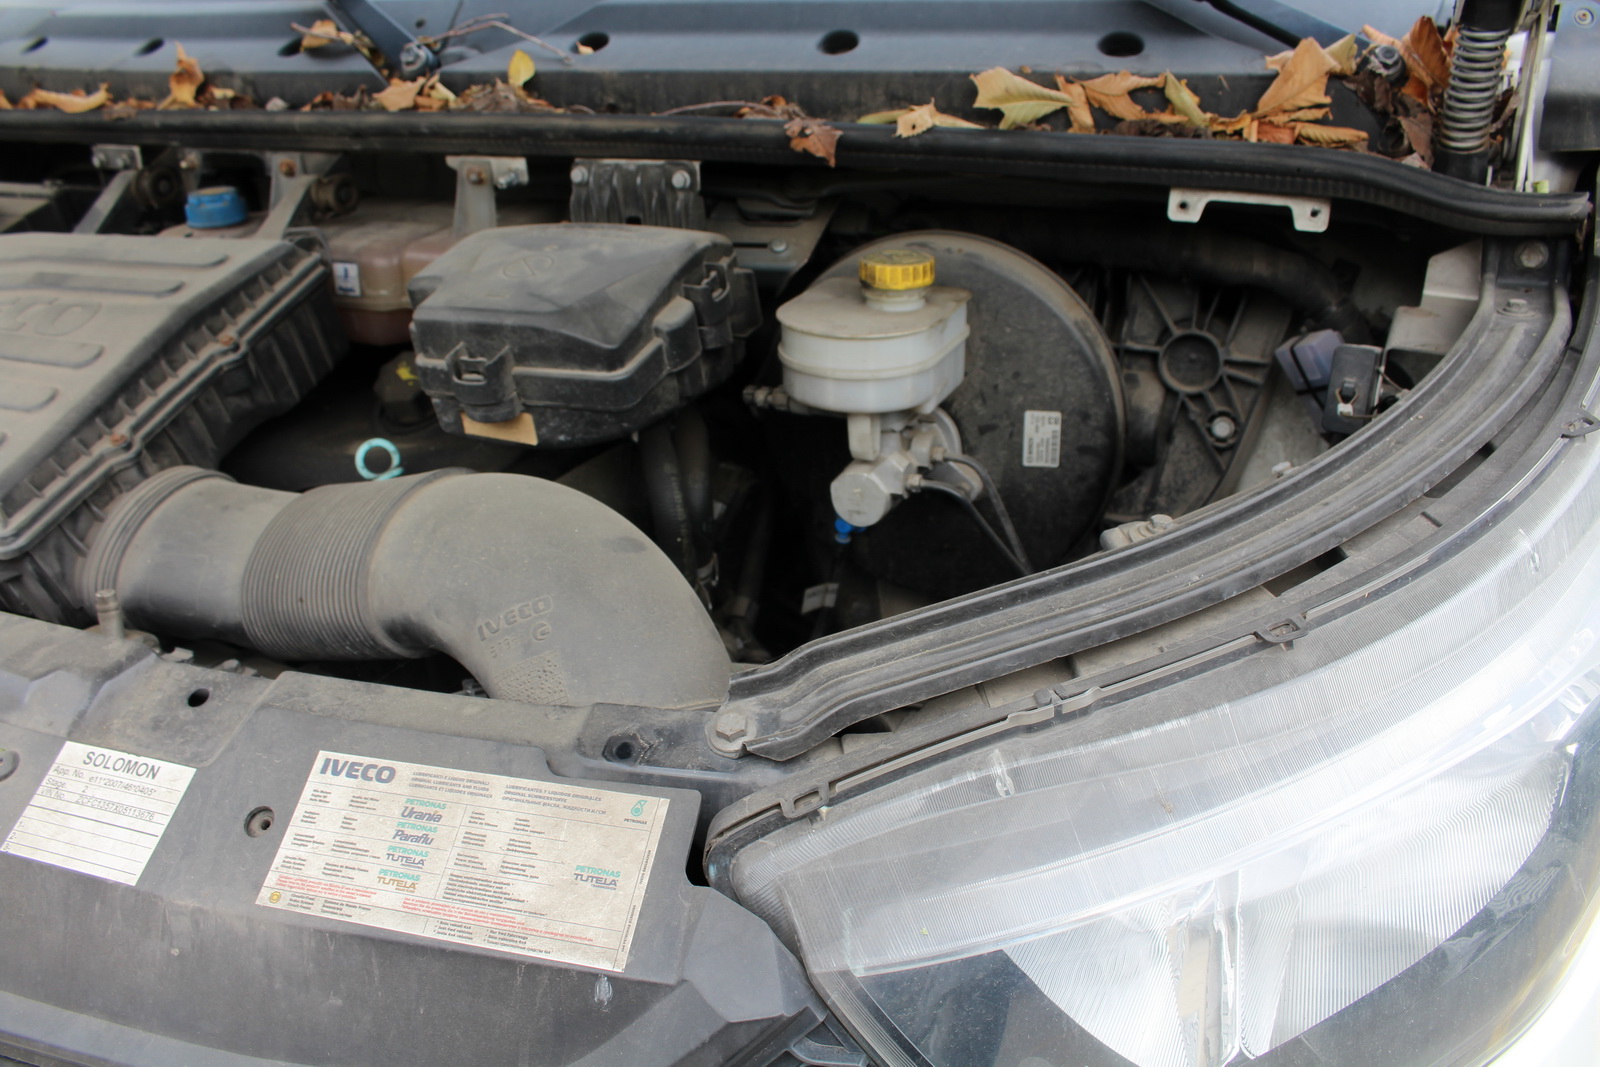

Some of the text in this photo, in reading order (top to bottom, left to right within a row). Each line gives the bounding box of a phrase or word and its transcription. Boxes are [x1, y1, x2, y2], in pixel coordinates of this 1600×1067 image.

[477, 595, 553, 642] IVECO
[83, 750, 161, 780] SOLOMON
[320, 758, 396, 783] IVECO
[81, 785, 89, 793] 2
[405, 798, 447, 810] PETRONAS
[401, 806, 443, 823] Urania
[397, 821, 438, 833] PETRONAS
[392, 829, 434, 845] Paraflu
[387, 845, 429, 858] PETRONAS
[386, 852, 426, 866] TUTELA
[379, 868, 420, 882] PETRONAS
[575, 865, 621, 878] PETRONAS
[377, 876, 418, 890] TUTELA
[574, 873, 619, 887] TUTELA
